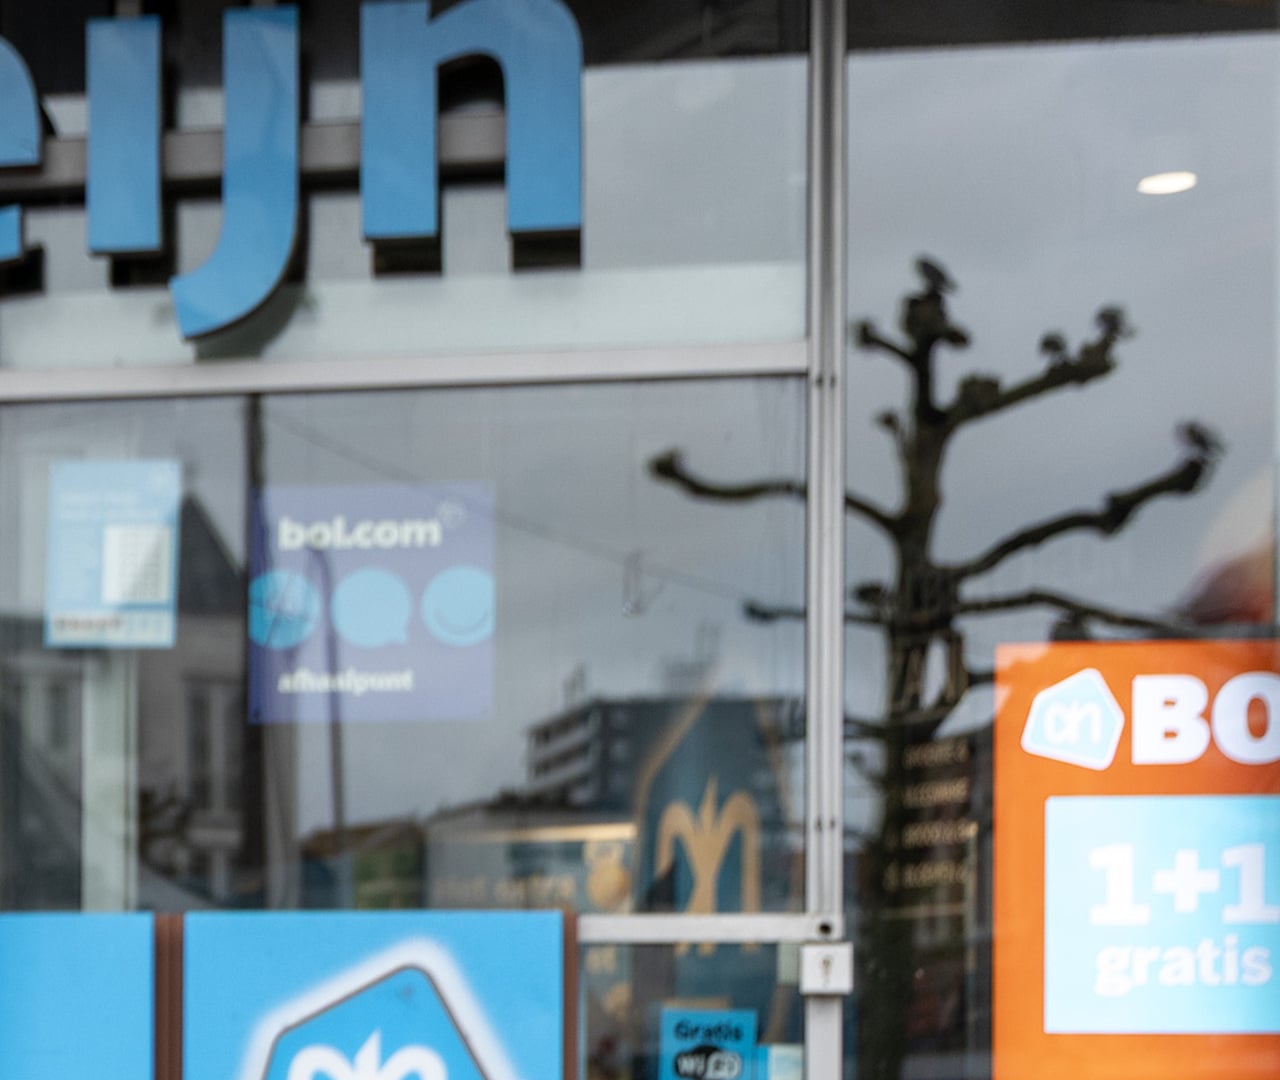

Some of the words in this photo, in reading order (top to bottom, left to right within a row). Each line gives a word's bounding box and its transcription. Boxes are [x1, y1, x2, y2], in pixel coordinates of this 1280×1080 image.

[278, 511, 442, 551] bol.com
[1088, 842, 1280, 927] 1+1
[1094, 934, 1273, 998] gratis
[673, 1019, 744, 1042] Gratis
